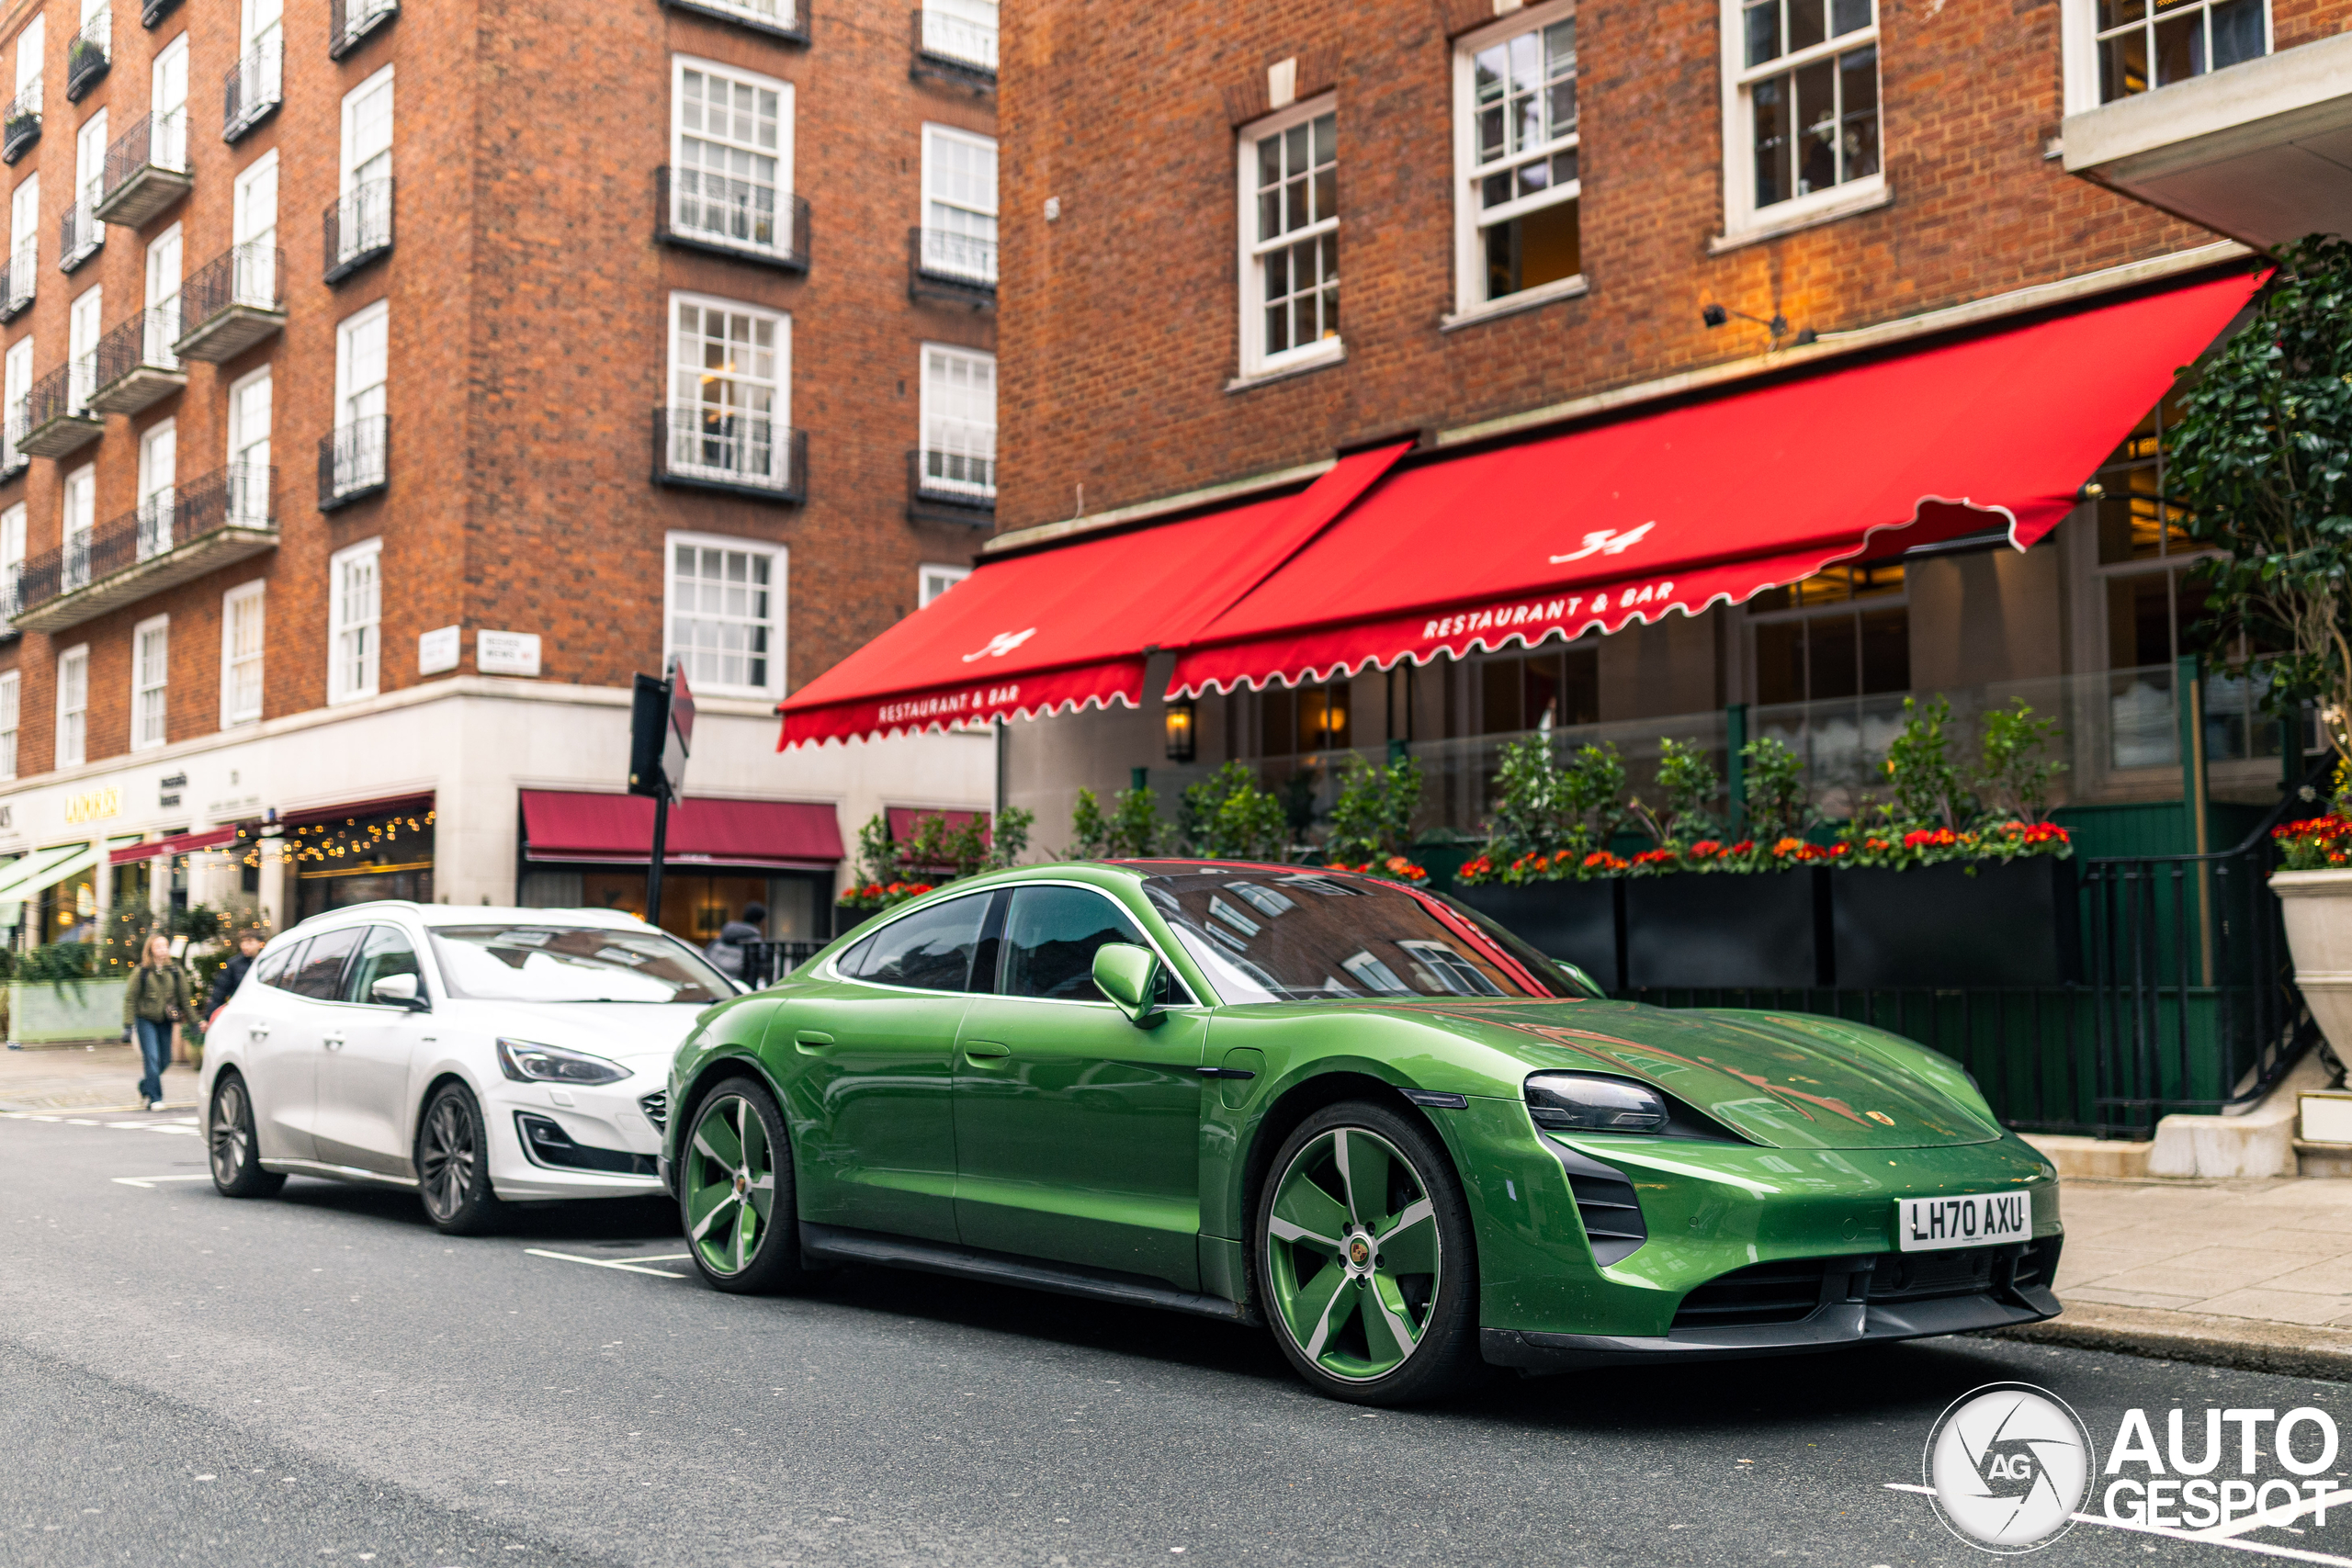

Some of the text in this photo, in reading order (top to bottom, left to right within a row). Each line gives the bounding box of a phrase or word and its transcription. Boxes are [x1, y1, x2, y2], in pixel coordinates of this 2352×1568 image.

[1422, 581, 1674, 639] RESTAURANT & BAR
[878, 684, 1020, 724] RESTAURANT & BAR
[1913, 1197, 2021, 1240] LH70 AXU
